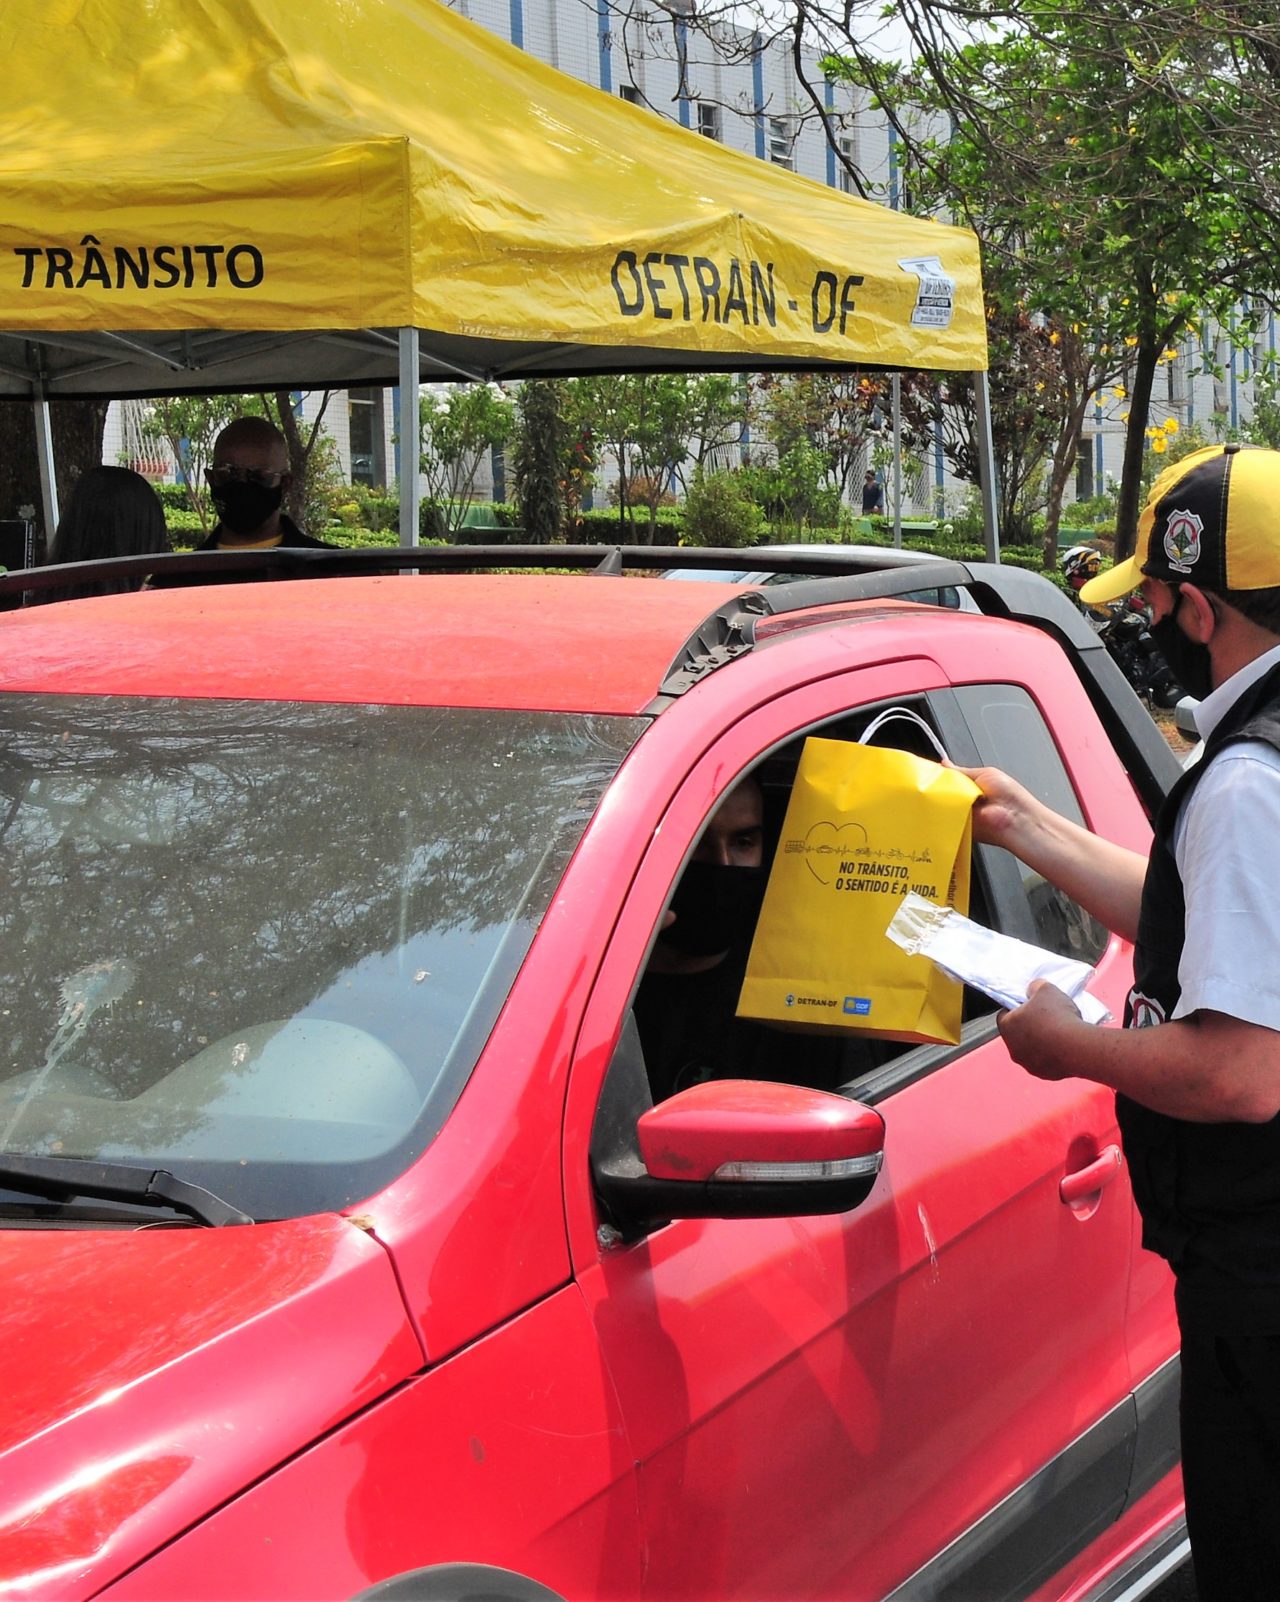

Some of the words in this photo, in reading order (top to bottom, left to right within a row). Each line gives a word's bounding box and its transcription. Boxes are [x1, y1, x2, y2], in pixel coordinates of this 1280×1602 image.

[14, 235, 264, 289] TRÂNSITO
[611, 250, 777, 327] DETRAN
[811, 270, 864, 336] DF
[839, 861, 855, 875] NO
[857, 861, 910, 880] TRÂNSITO,
[835, 878, 844, 890] O
[845, 878, 890, 893] SENTIDO
[891, 880, 899, 895] É
[900, 883, 908, 896] A
[911, 884, 939, 898] VIDA.
[797, 997, 838, 1007] DETRAN-DF
